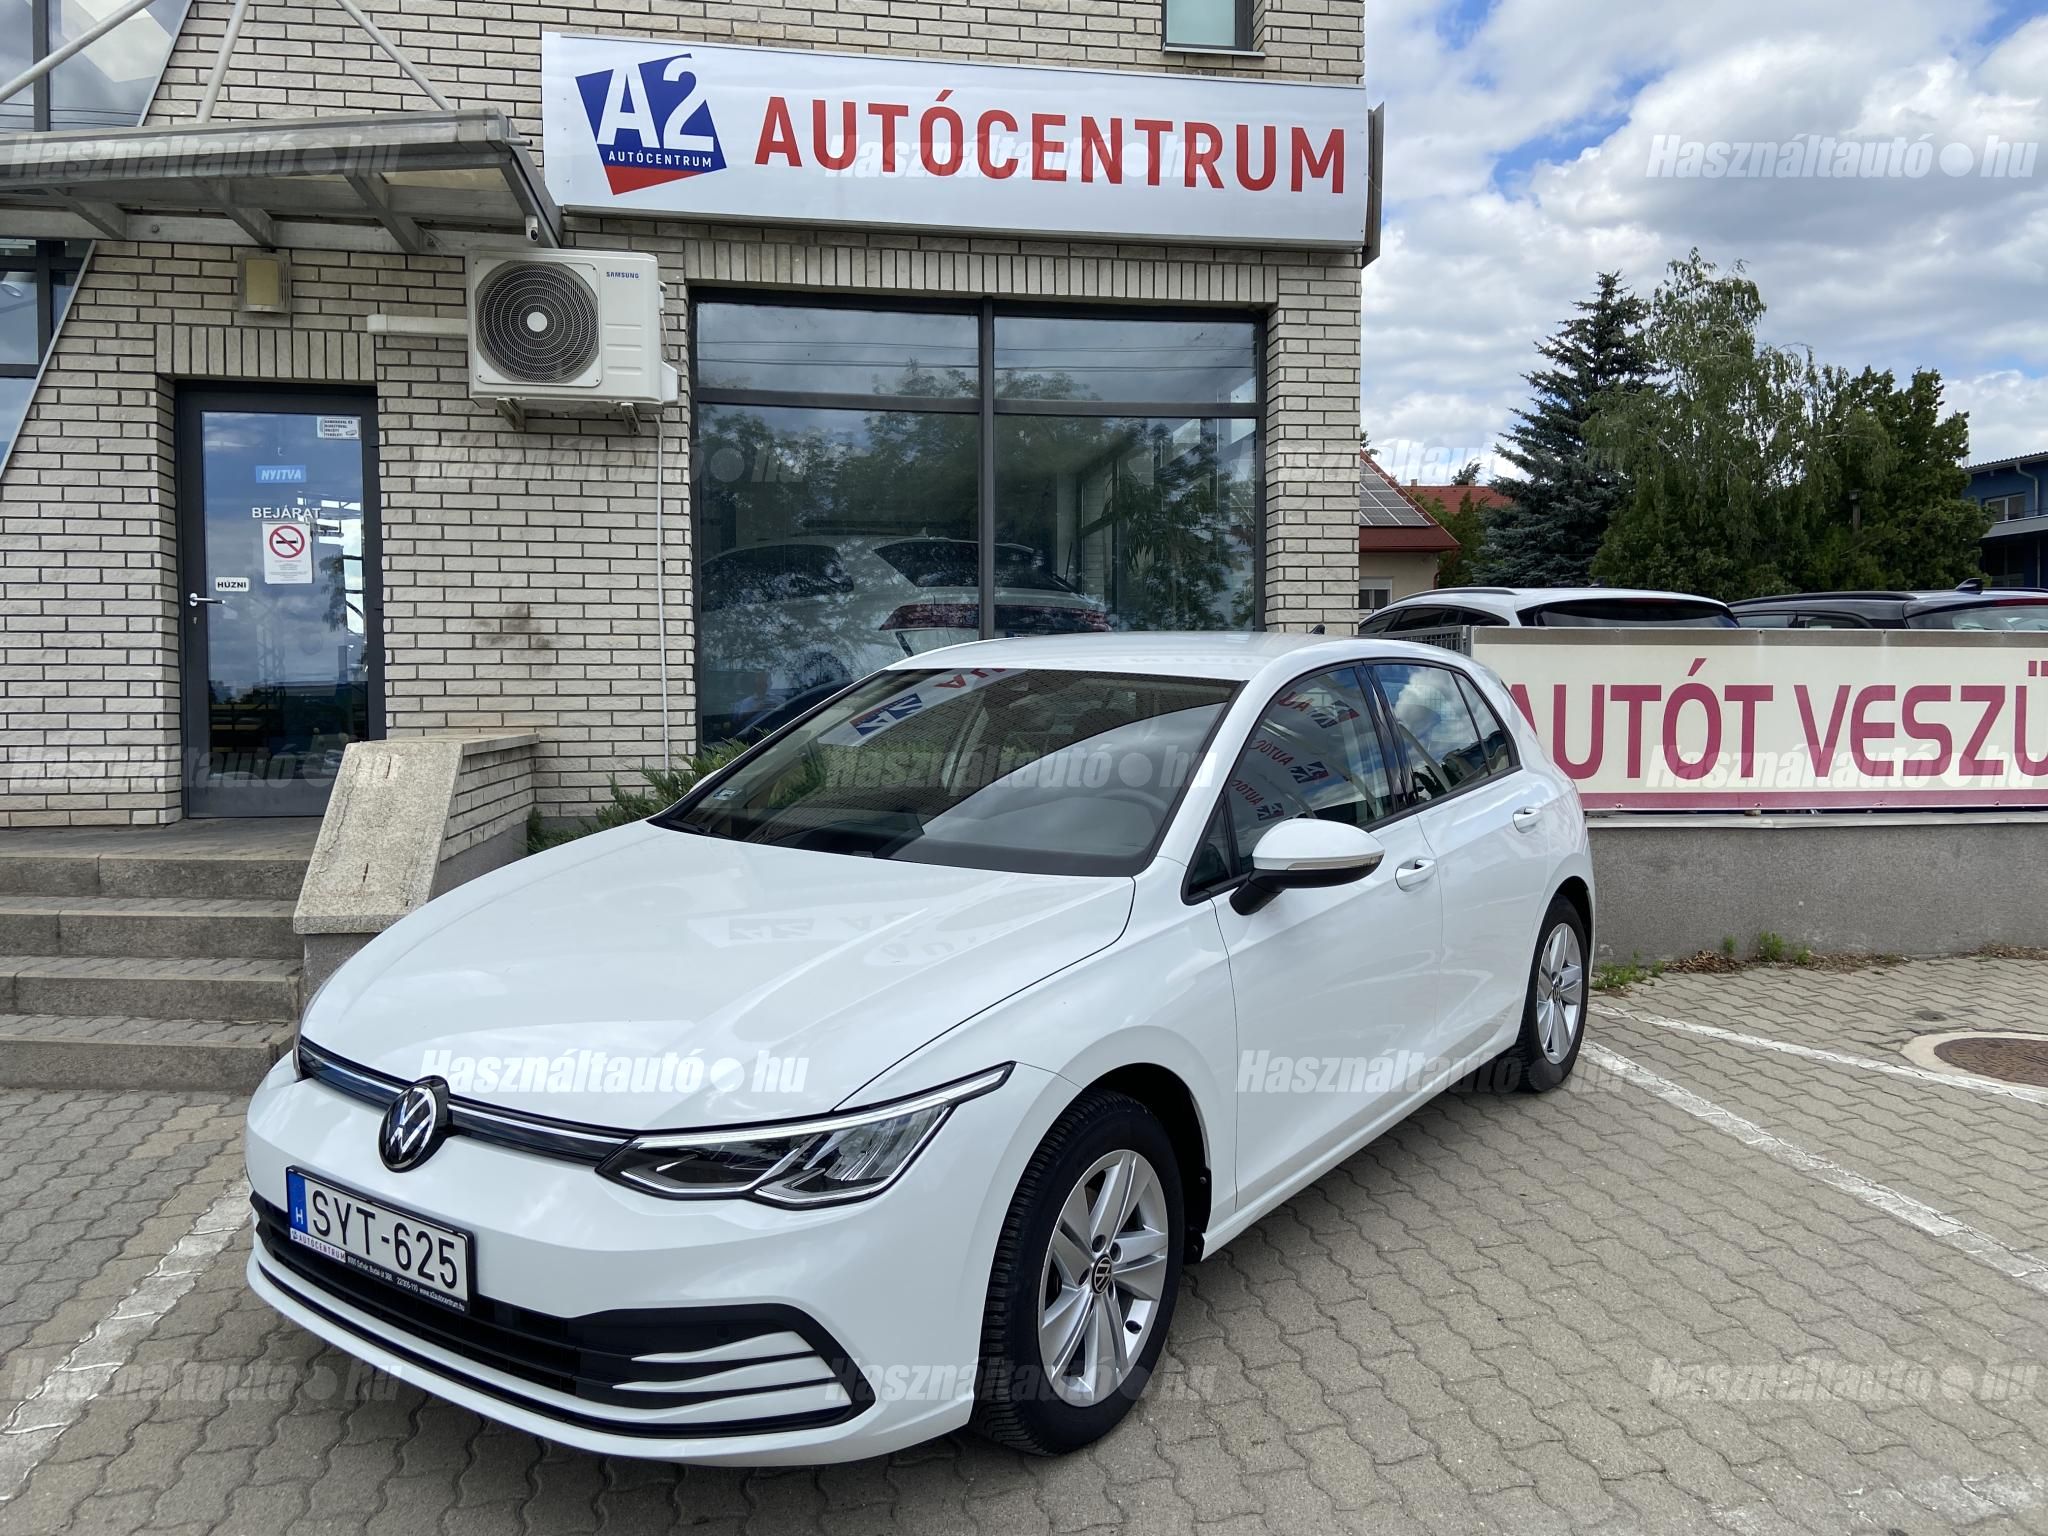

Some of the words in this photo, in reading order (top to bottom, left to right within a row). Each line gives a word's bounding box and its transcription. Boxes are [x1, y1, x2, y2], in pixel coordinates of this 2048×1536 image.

[597, 57, 714, 152] A2
[755, 90, 1344, 194] AUTÓCENTRUM
[608, 150, 712, 168] AUTÓCENTRUM
[606, 271, 640, 279] SAMSUNG
[261, 469, 302, 481] NYITVA
[252, 505, 321, 519] BEJÁRAT
[217, 581, 247, 589] HÚZNI
[1510, 658, 1774, 780] UTÓT
[1794, 660, 2048, 777] VESZÜ
[295, 1207, 304, 1225] H
[312, 1189, 457, 1289] SYT-625
